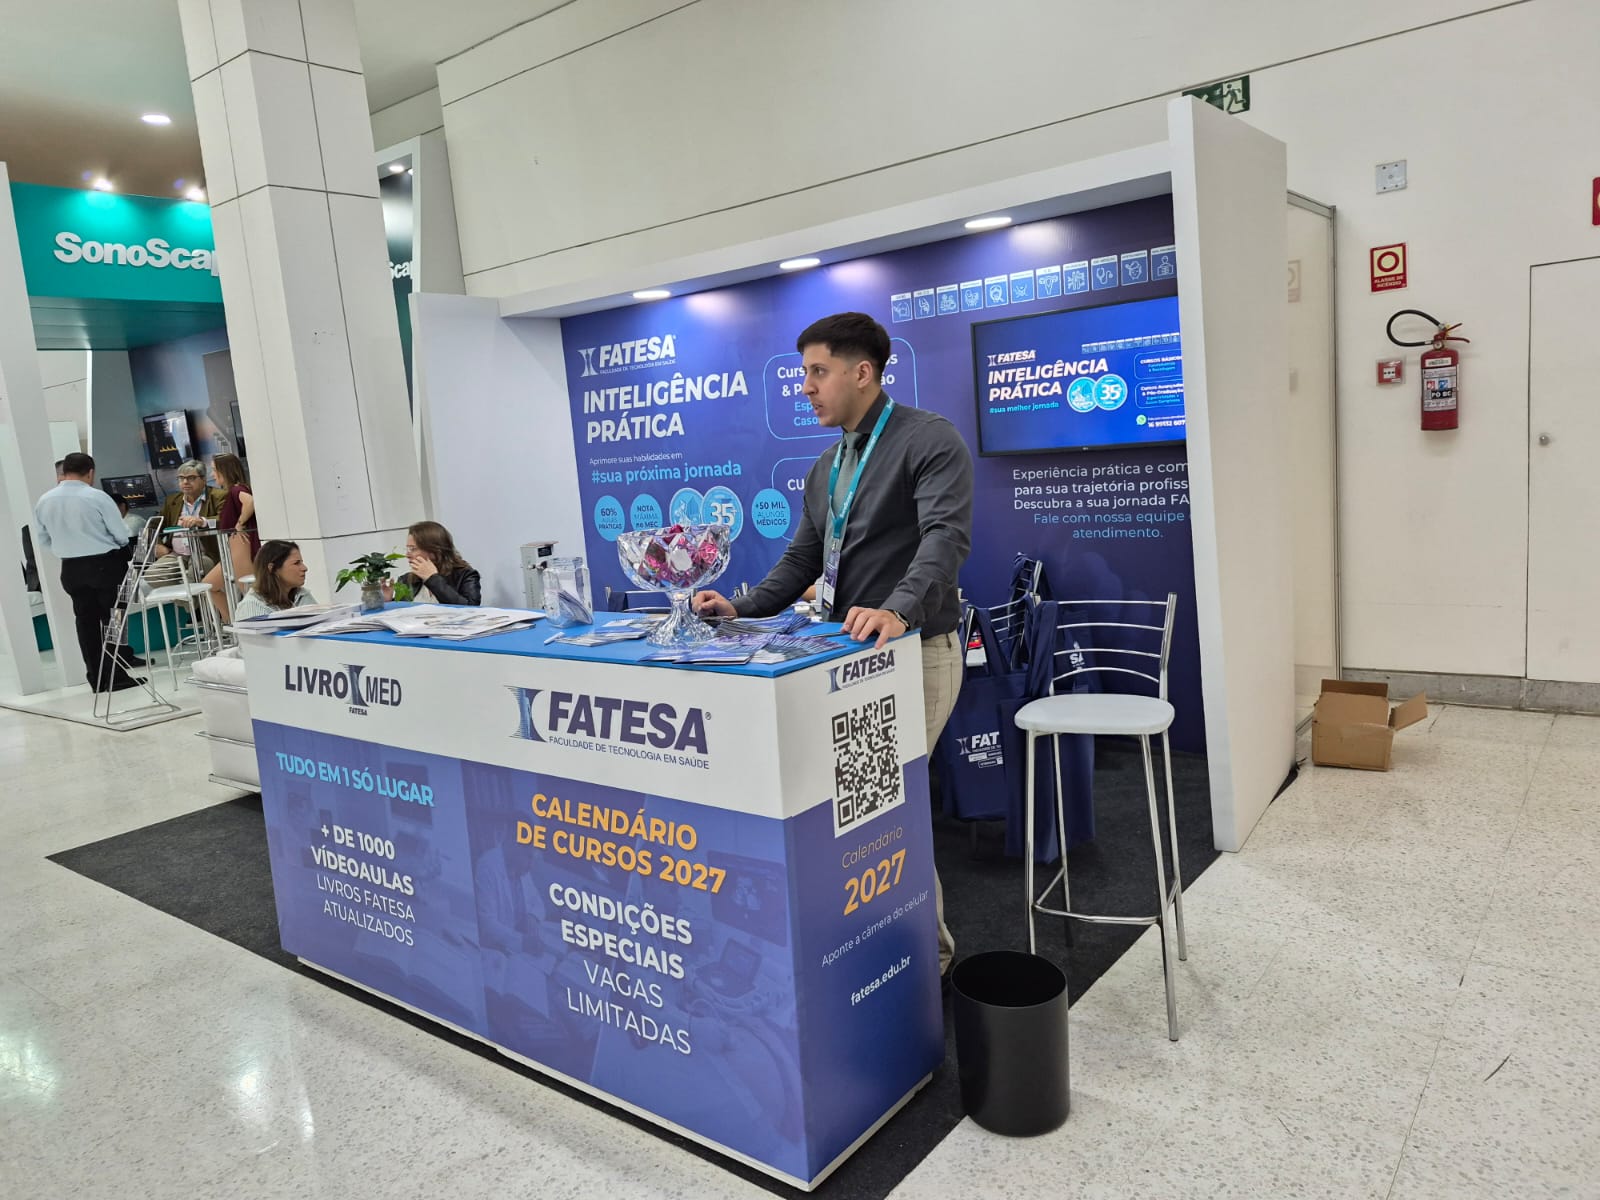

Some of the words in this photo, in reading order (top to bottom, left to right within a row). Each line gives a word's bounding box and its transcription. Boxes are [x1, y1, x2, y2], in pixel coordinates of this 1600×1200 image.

[988, 358, 1109, 385] INTELIGÊNCIA
[997, 349, 1037, 364] FATESA
[583, 371, 749, 414] INTELIGÊNCIA
[781, 384, 791, 397] &
[989, 380, 1063, 402] PRÁTICA
[1007, 403, 1032, 413] melhor
[1032, 400, 1060, 411] jornada
[587, 411, 685, 444] PRÁTICA
[589, 456, 618, 466] Aprimore
[618, 455, 633, 463] suas
[633, 453, 671, 463] habilidades
[671, 452, 683, 460] em
[591, 471, 623, 484] #sua
[626, 464, 681, 485] próxima
[684, 459, 742, 482] jornada
[1013, 465, 1088, 482] Experiência
[1092, 463, 1141, 479] prática
[1144, 465, 1154, 474] e
[771, 500, 786, 510] MIL
[1014, 485, 1043, 498] para
[1045, 485, 1069, 495] sua
[1072, 479, 1135, 496] trajetória
[1139, 477, 1189, 493] profiss
[1014, 498, 1072, 510] Descubra
[1075, 500, 1084, 508] a
[1087, 498, 1110, 508] sua
[1112, 494, 1166, 510] jornada
[1170, 493, 1190, 506] FA
[600, 507, 618, 517] 60%
[636, 504, 654, 512] NOTA
[756, 516, 788, 526] MÉDICOS
[1034, 513, 1060, 525] Fale
[1062, 514, 1091, 524] com
[1094, 513, 1132, 523] nossa
[1136, 510, 1185, 525] equipe
[1072, 527, 1164, 539] atendimento.
[842, 649, 895, 684] FATESA
[285, 664, 349, 700] LIVRO
[365, 675, 402, 707] MED
[349, 706, 368, 716] FATESA
[548, 735, 594, 751] FACULDADE
[595, 742, 607, 753] DE
[608, 744, 662, 762] TECNOLOGIA
[663, 753, 677, 764] EM
[678, 755, 710, 770] SAÚDE
[275, 751, 316, 779] TUDO
[318, 762, 343, 787] EM
[343, 768, 350, 788] 1
[352, 767, 373, 793] SÓ
[377, 774, 435, 808] LUGAR
[531, 793, 698, 851] CALENDÁRIO
[321, 824, 330, 838] +
[333, 824, 355, 849] DE
[356, 831, 396, 861] 1000
[516, 821, 547, 849] DE
[552, 829, 653, 877] CURSOS
[659, 855, 727, 894] 2027
[841, 824, 904, 870] Calendário
[310, 844, 415, 897] VÍDEOAULAS
[843, 847, 907, 917] 2027
[316, 873, 362, 903] LIVROS
[364, 889, 416, 923] FATESA
[549, 882, 693, 945] CONDIÇÕES
[323, 898, 414, 947] ATUALIZADOS
[821, 940, 854, 969] Aponte
[855, 936, 861, 946] a
[861, 914, 892, 941] câmera
[893, 906, 904, 921] do
[904, 889, 930, 913] celular
[561, 919, 685, 980] ESPECIAIS
[583, 959, 664, 1009] VAGAS
[850, 955, 912, 1007] fatesa.edu.br
[567, 986, 692, 1055] LIMITADAS
